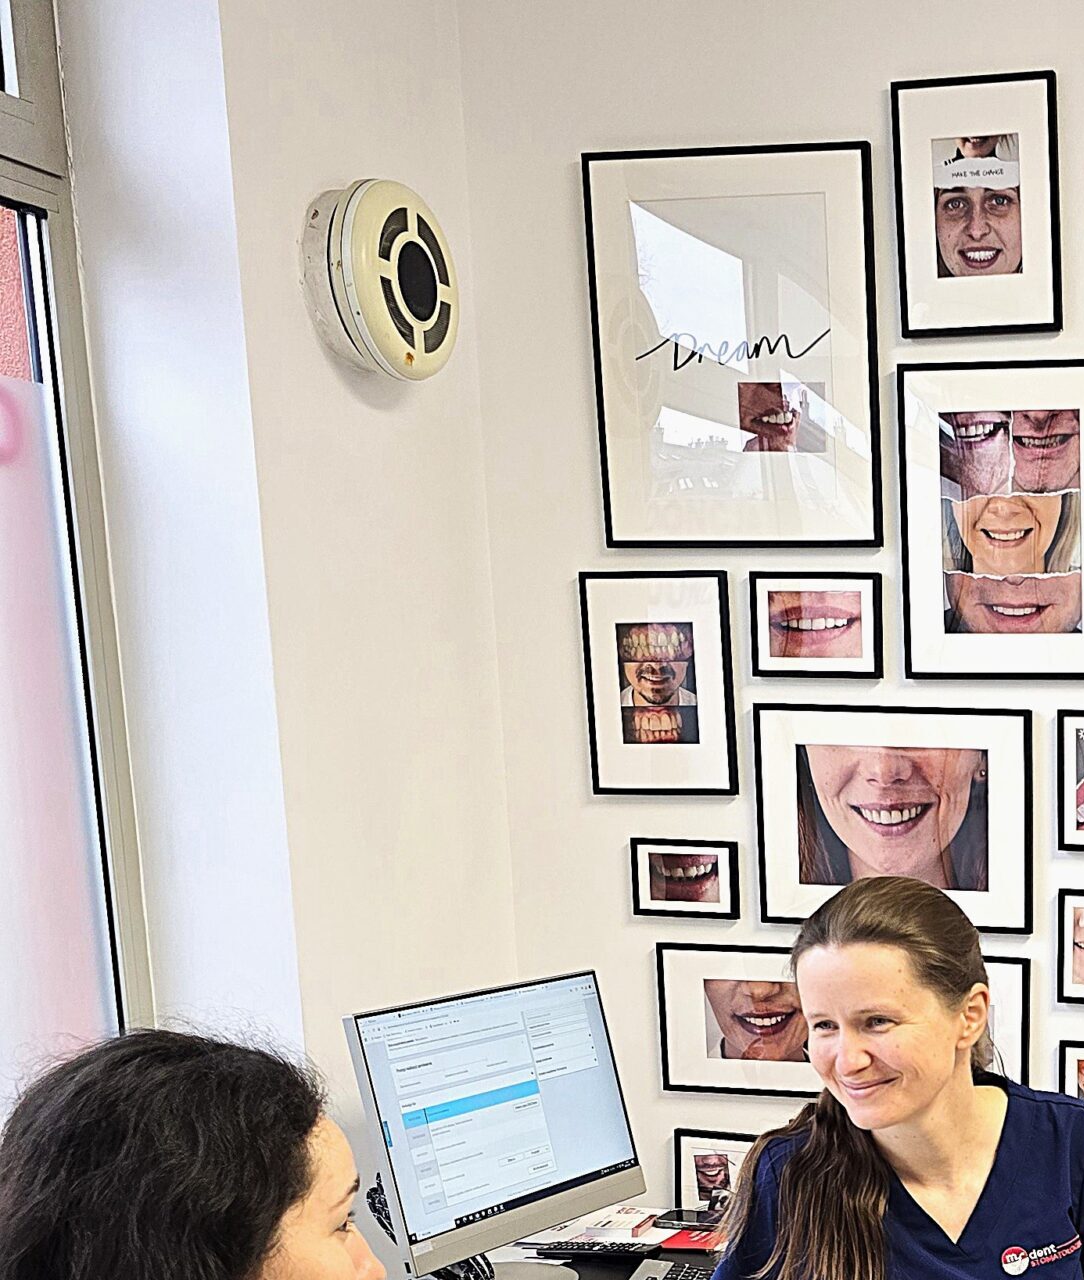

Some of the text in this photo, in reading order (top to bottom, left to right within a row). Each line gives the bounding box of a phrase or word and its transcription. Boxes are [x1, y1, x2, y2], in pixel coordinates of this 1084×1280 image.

[982, 168, 1005, 177] CHANGE
[635, 332, 831, 372] Dream
[1029, 1244, 1057, 1260] dent
